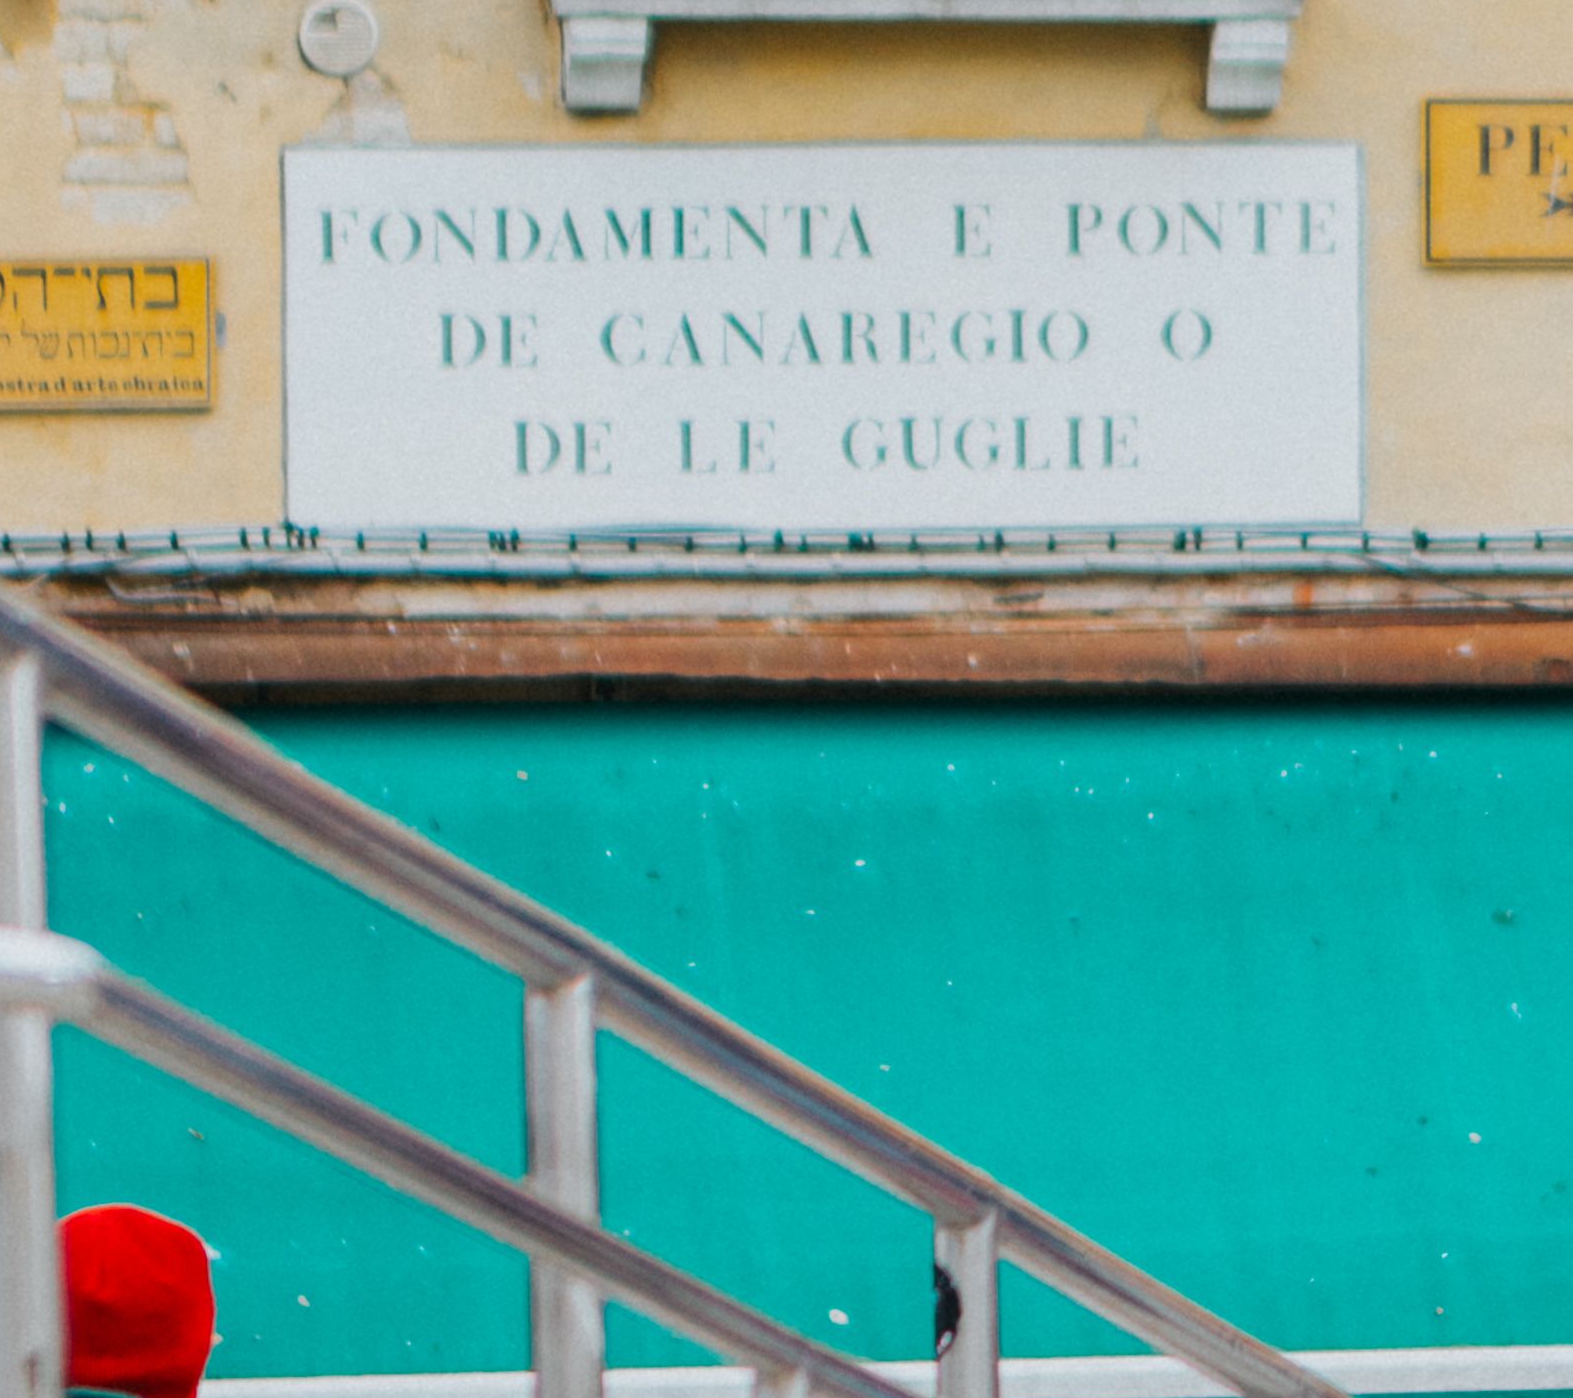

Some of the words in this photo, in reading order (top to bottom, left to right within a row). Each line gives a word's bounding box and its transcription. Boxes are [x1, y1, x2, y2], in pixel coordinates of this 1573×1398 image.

[317, 202, 875, 266] FONDAMENTA
[951, 202, 993, 260] E
[1064, 200, 1339, 258] PONTE
[438, 311, 539, 370] DE
[599, 306, 1090, 367] CANAREGIO
[1159, 306, 1215, 363] O
[512, 420, 614, 477] DE
[678, 418, 777, 475] LE
[840, 415, 1141, 473] GUGLIE
